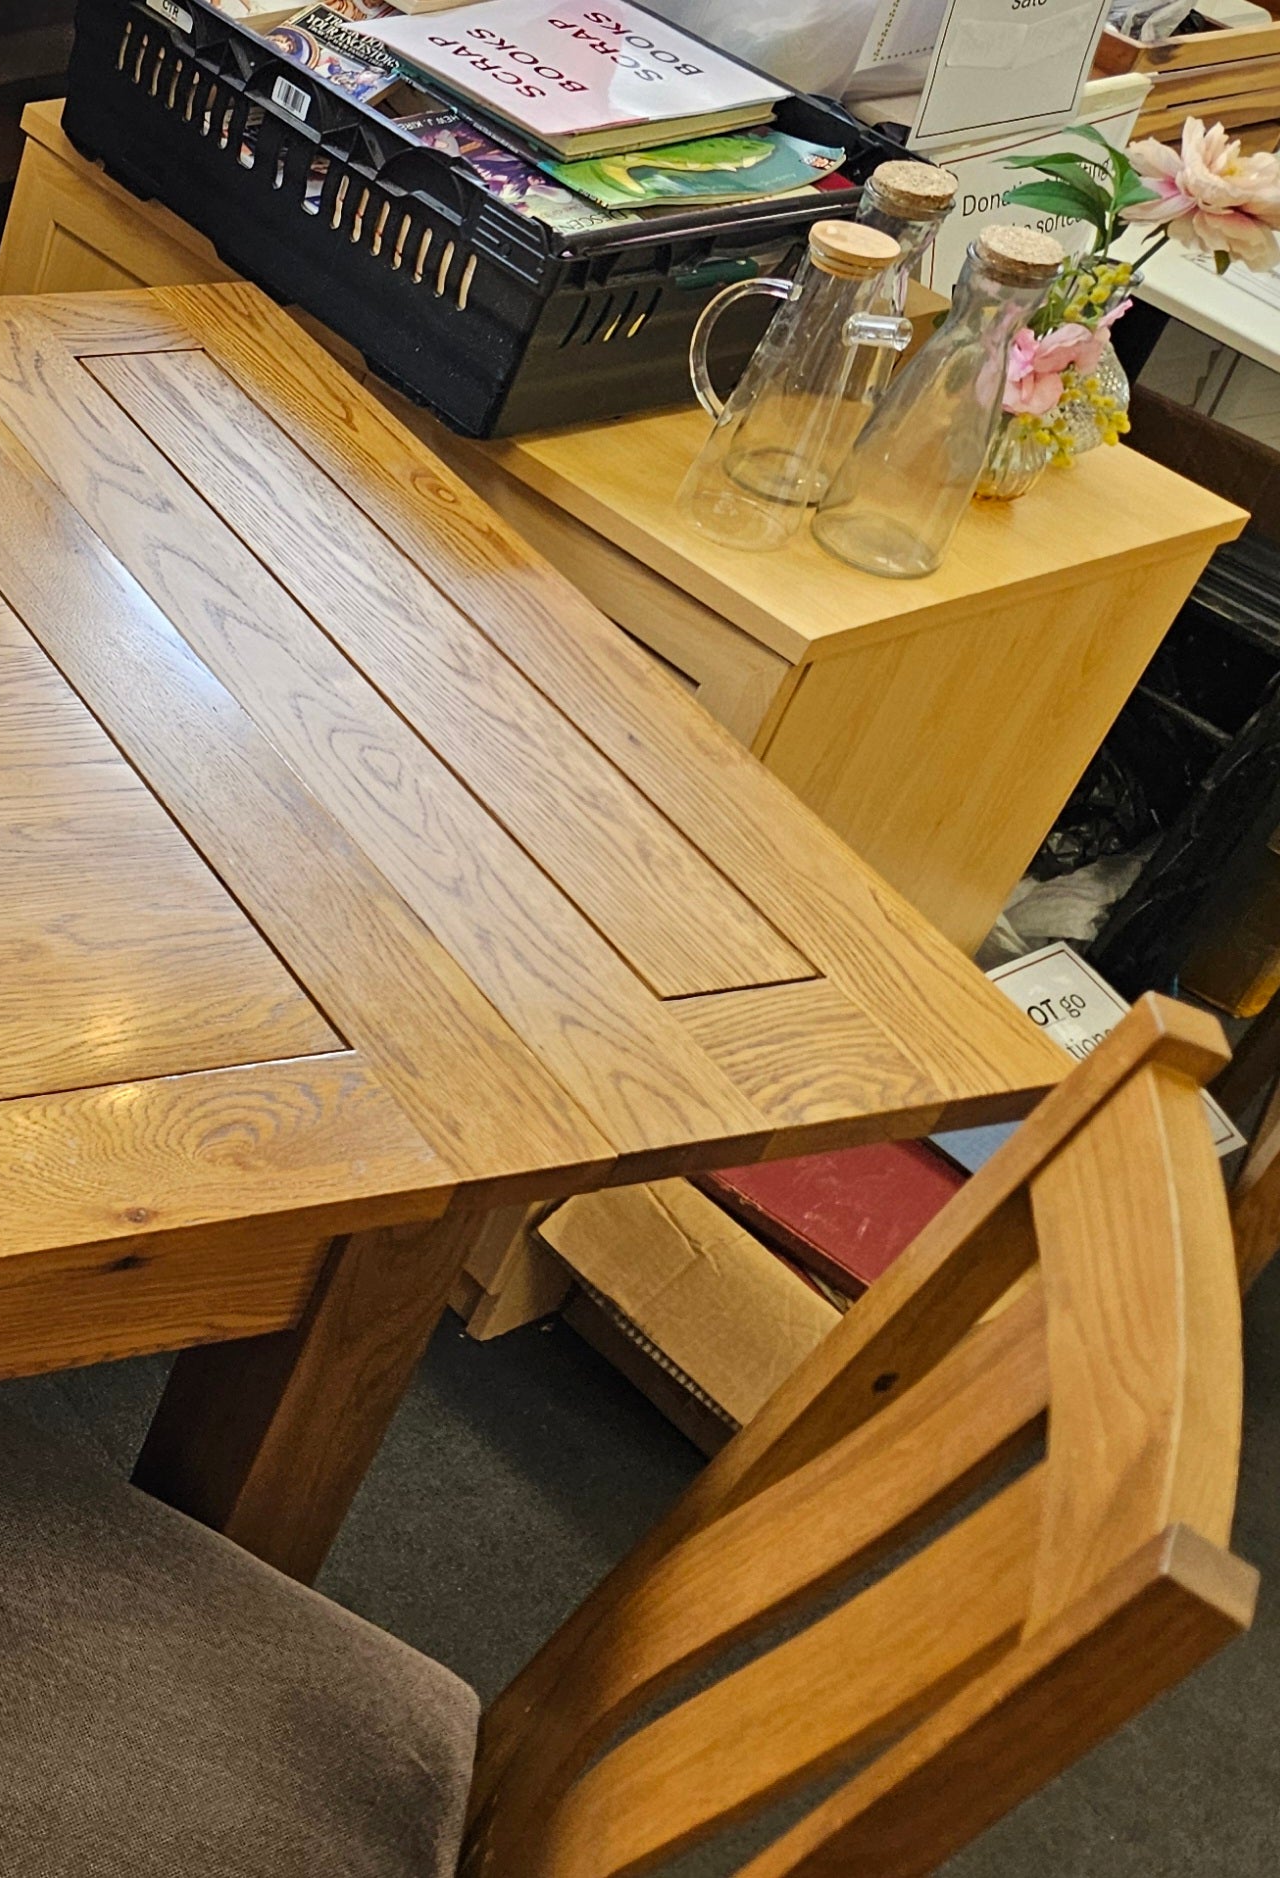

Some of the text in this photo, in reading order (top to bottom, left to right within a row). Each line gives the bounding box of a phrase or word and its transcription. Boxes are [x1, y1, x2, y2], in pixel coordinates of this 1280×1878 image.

[306, 14, 335, 37] YOUR
[547, 18, 664, 82] SCRAP
[583, 11, 705, 76] BOOKS
[428, 36, 546, 98] SCRAP
[466, 27, 590, 93] BOOKS
[1026, 993, 1087, 1027] OT go
